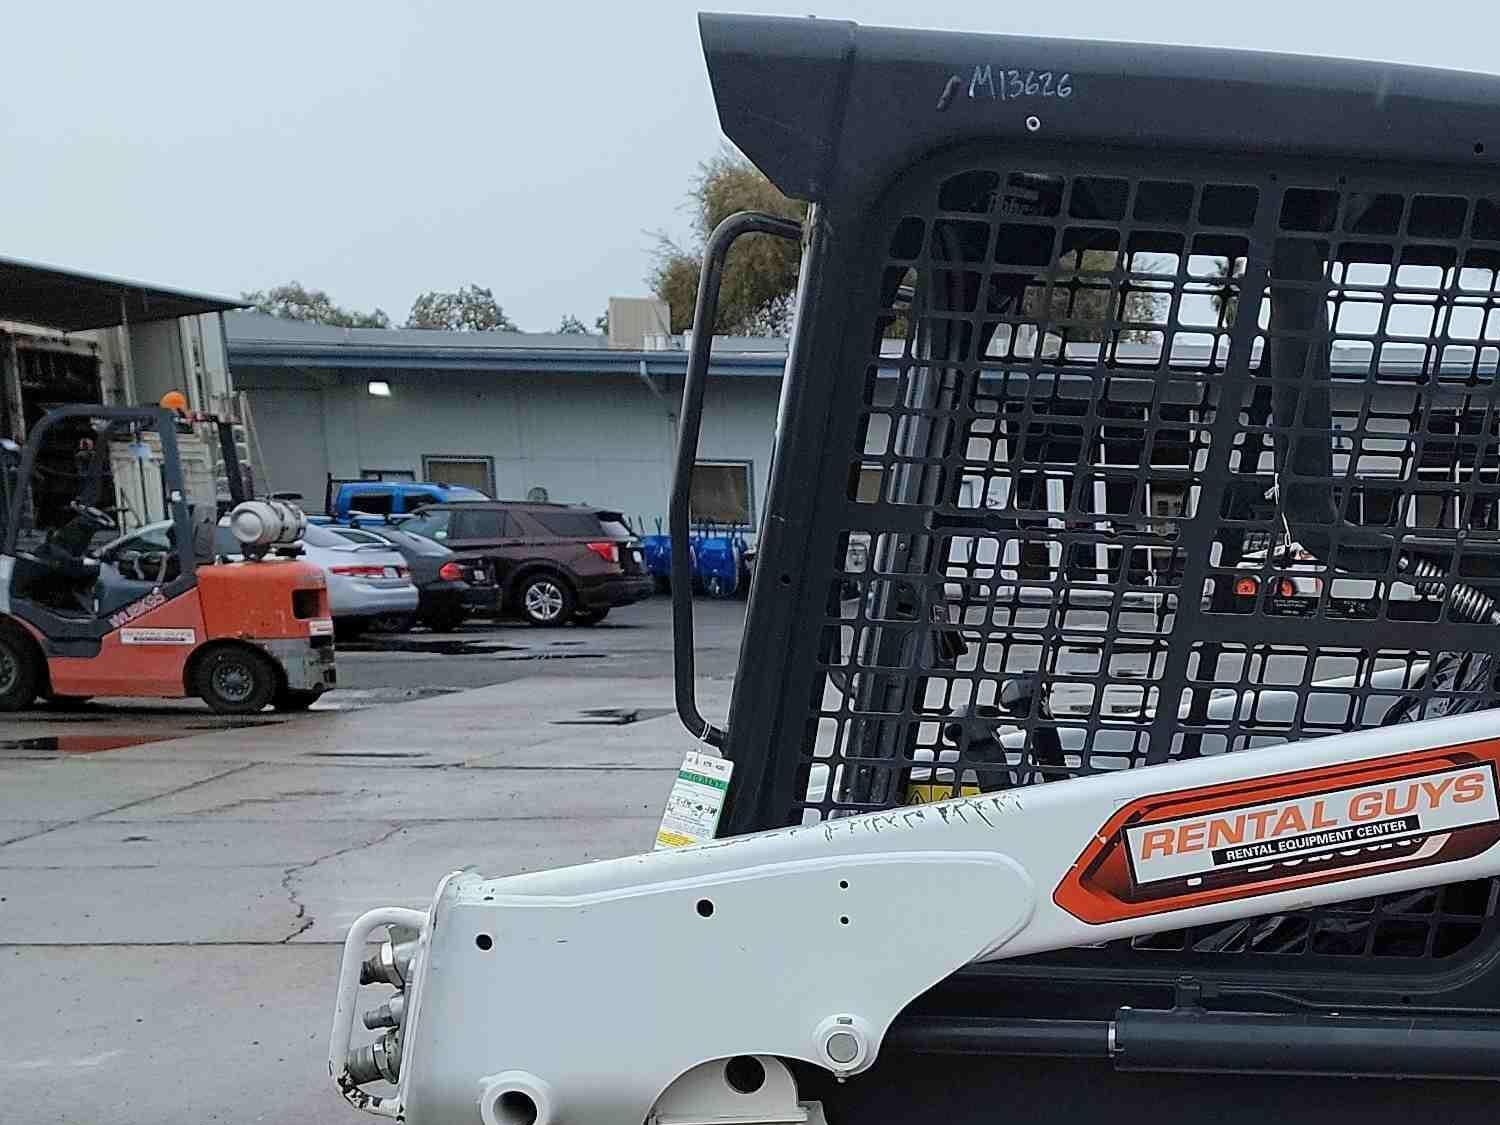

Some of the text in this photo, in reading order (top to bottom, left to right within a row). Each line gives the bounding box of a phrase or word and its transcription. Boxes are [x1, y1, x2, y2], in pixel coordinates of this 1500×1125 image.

[968, 63, 1073, 101] M13626
[1142, 800, 1337, 860] RENTAL
[1348, 771, 1485, 822] GUYS
[1227, 843, 1273, 861] RENTAL
[1278, 829, 1353, 850] EQUIPMENT
[1357, 819, 1407, 837] CENTER
